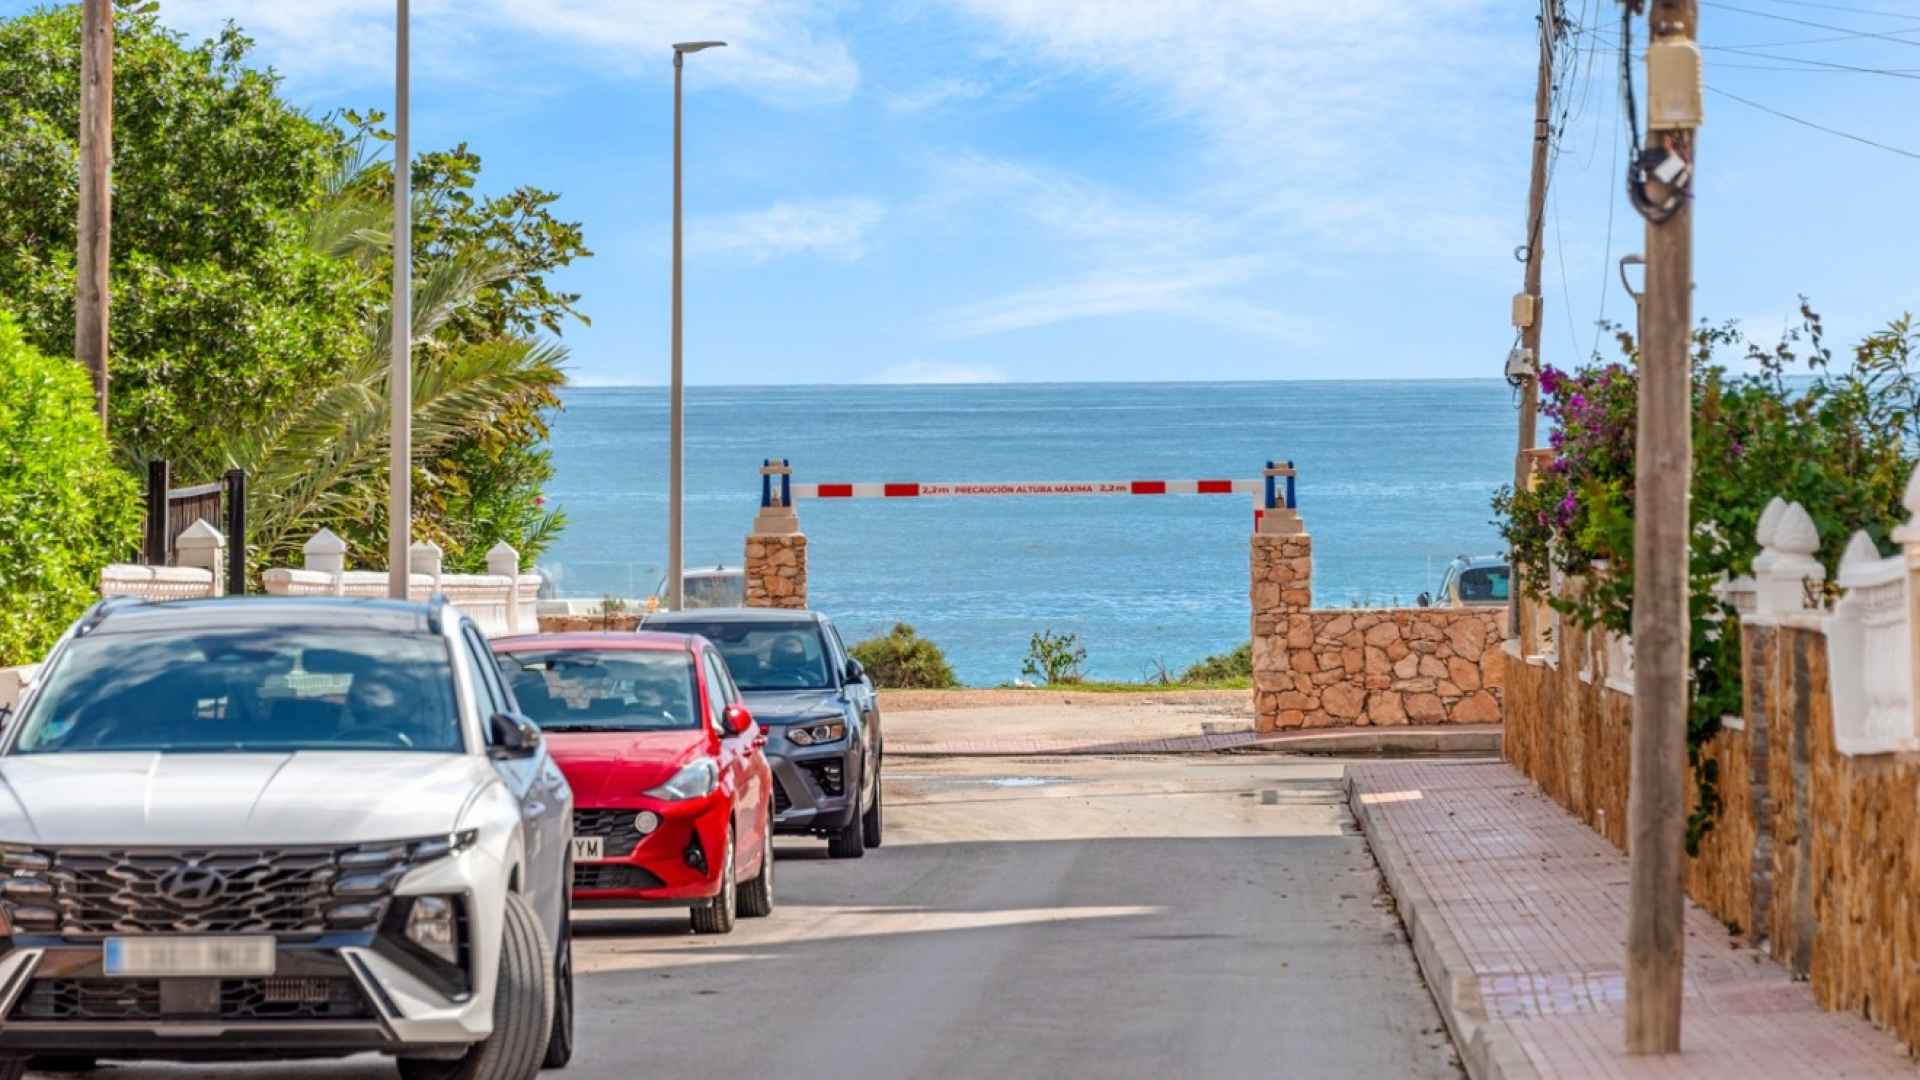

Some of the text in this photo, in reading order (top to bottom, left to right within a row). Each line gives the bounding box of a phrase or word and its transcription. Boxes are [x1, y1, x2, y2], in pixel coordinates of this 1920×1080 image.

[954, 483, 1014, 494] PRECAUCIÓN
[1015, 485, 1053, 493] ALTURA
[1055, 483, 1093, 493] MÁXIMA
